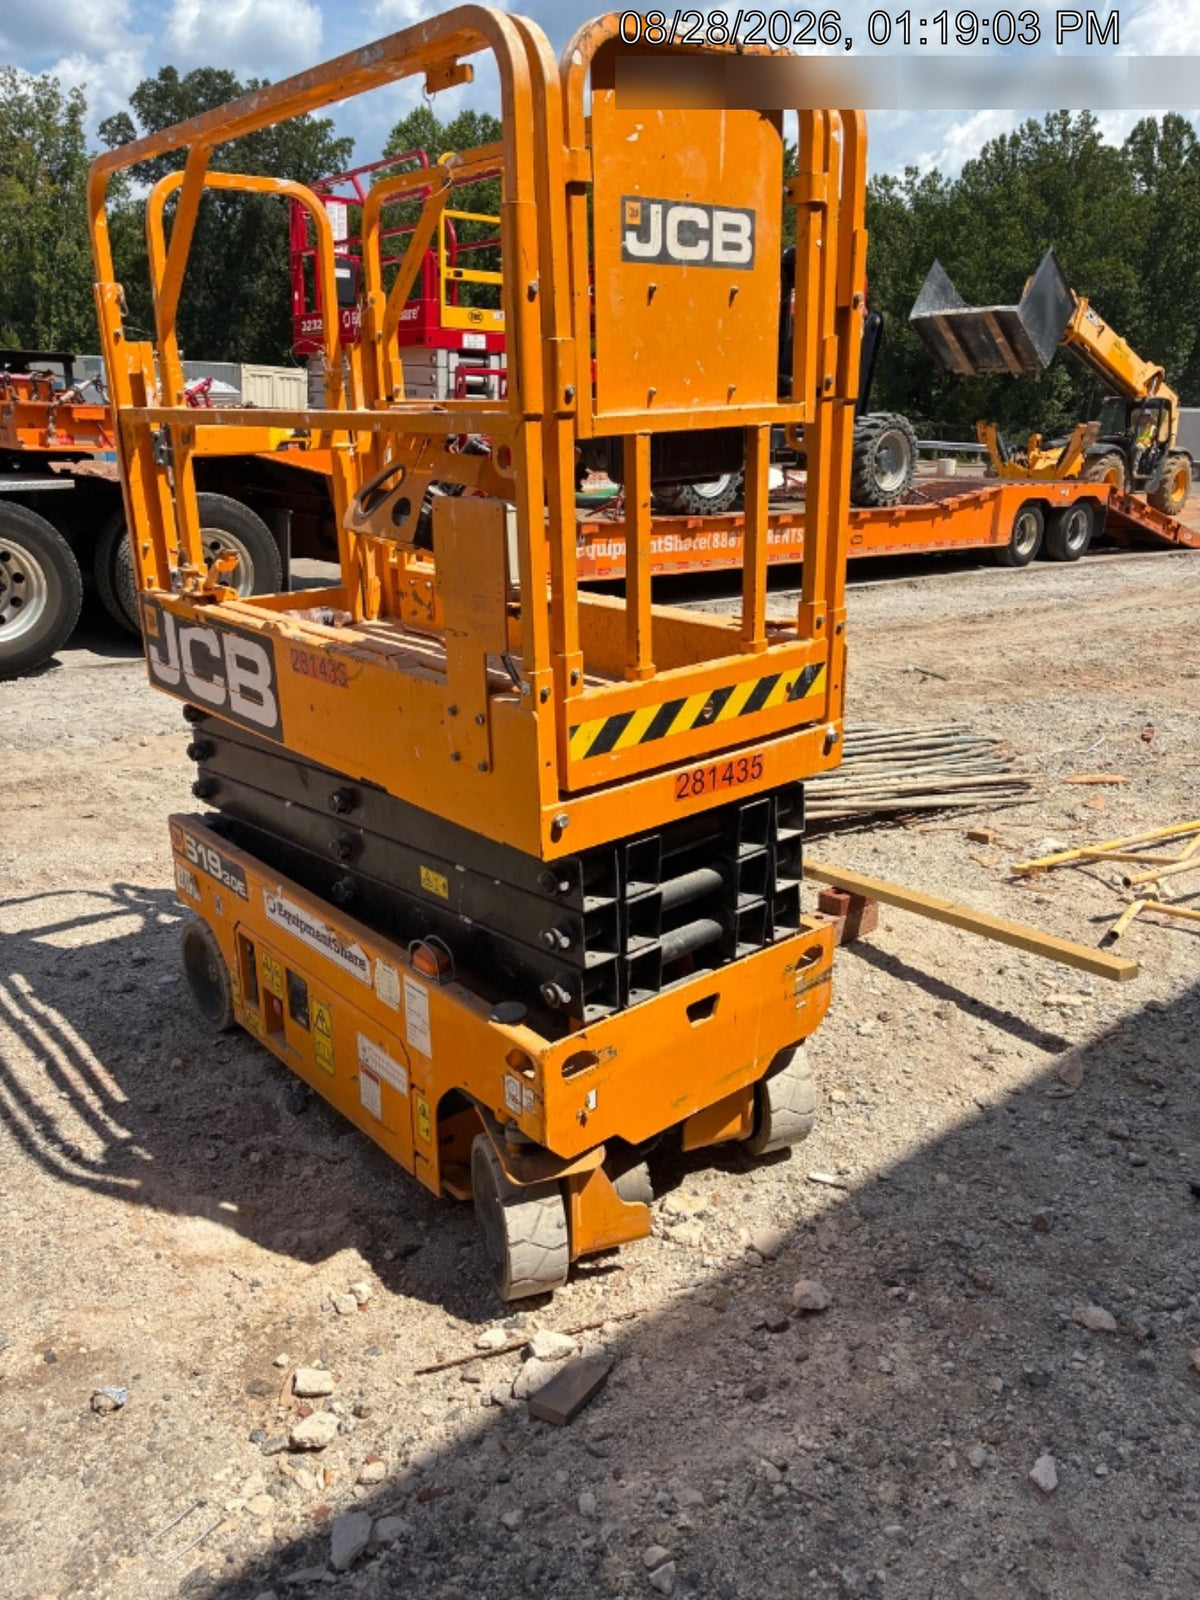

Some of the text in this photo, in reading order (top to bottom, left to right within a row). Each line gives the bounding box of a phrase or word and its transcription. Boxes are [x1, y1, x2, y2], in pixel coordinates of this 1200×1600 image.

[625, 203, 753, 264] JCB
[149, 610, 278, 728] JCB
[676, 753, 763, 799] 281435
